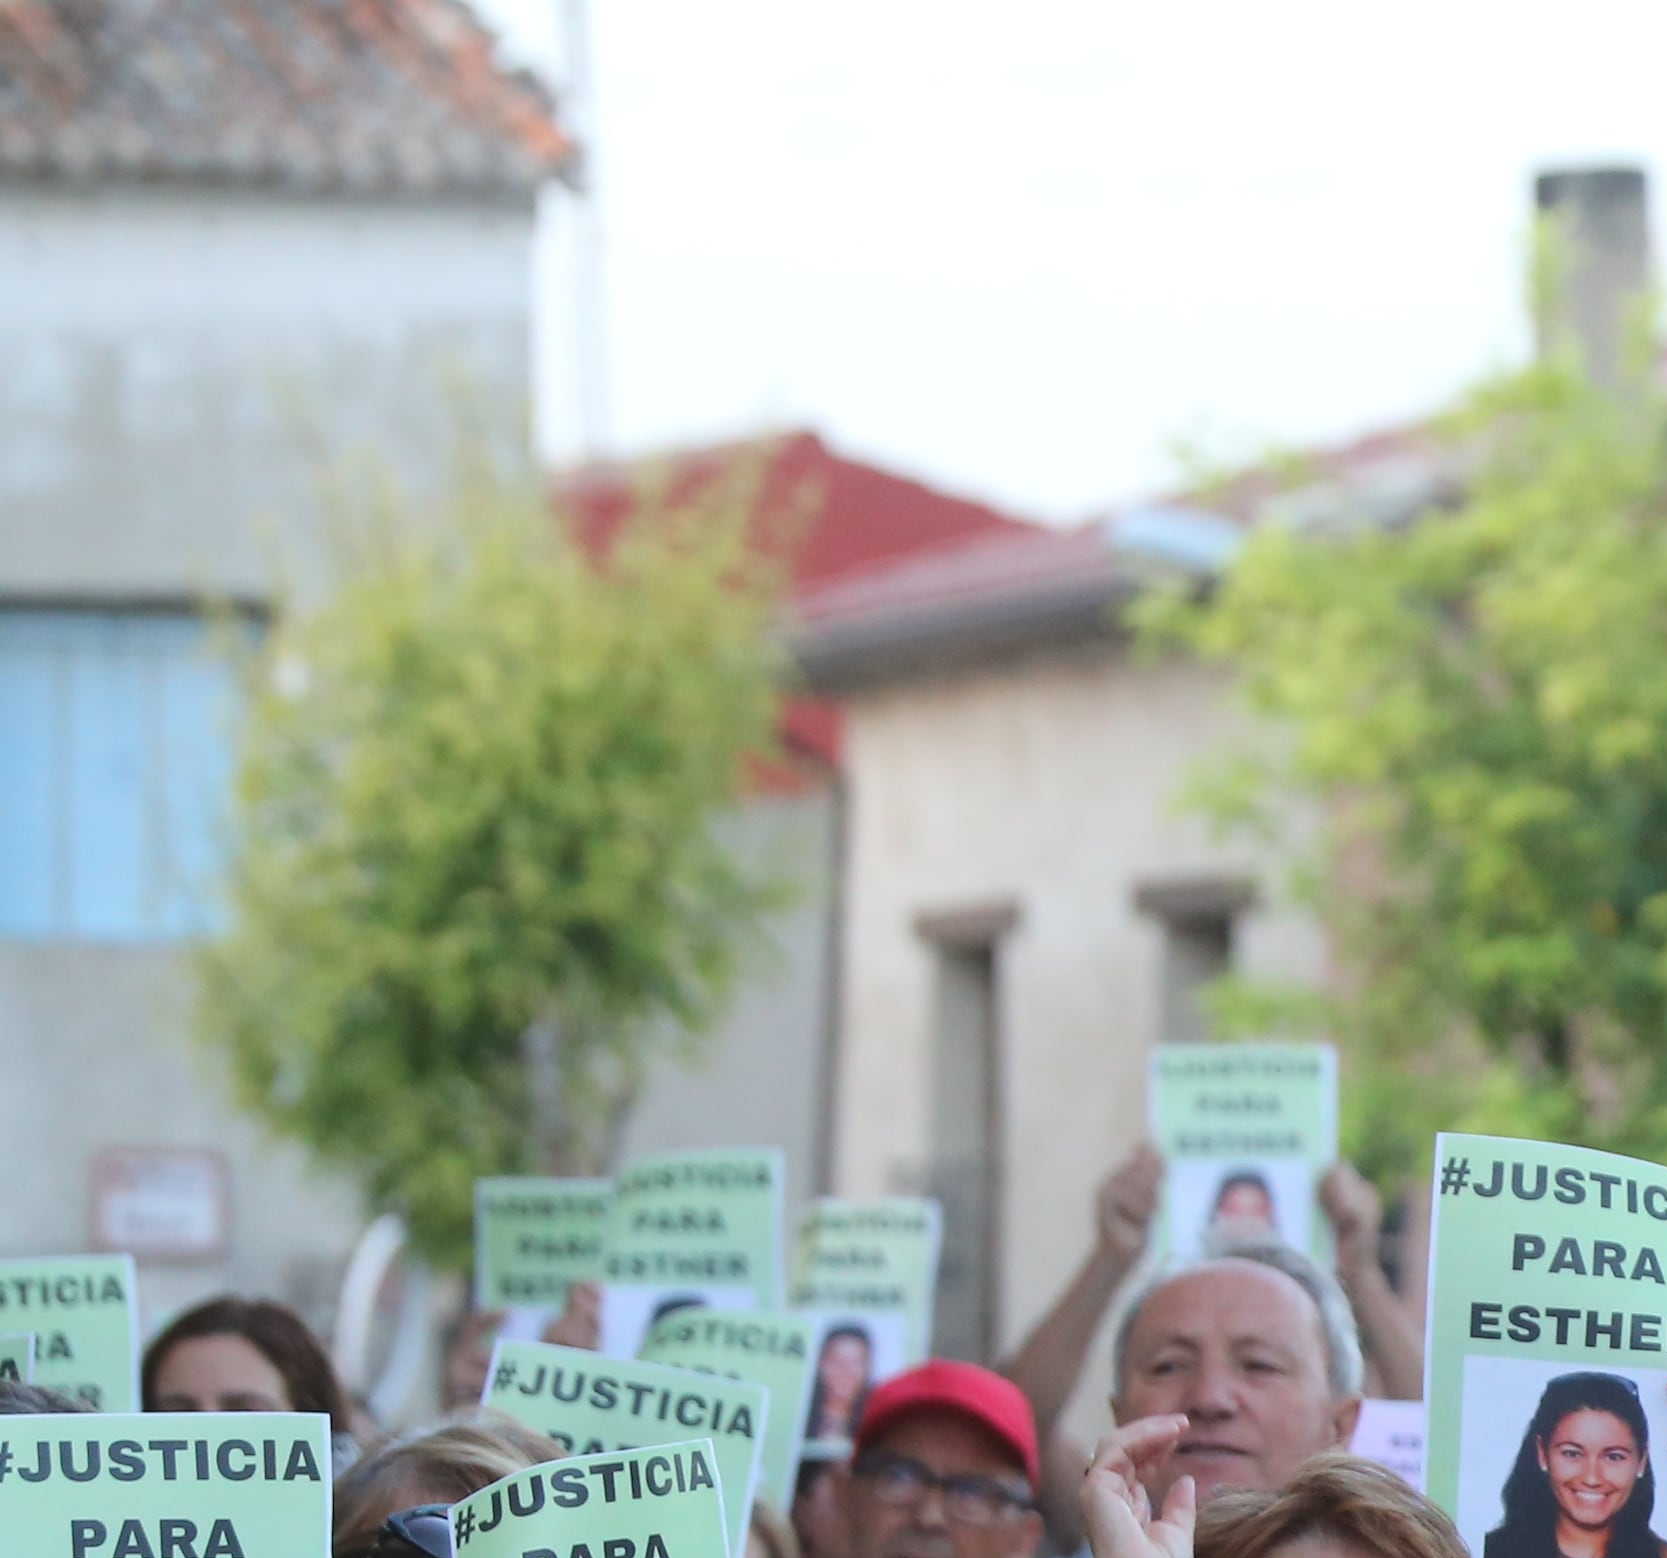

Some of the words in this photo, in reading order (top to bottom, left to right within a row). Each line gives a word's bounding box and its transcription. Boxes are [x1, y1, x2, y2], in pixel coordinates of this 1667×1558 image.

[0, 1273, 126, 1307] TICIA
[1512, 1233, 1666, 1285] PARA
[494, 1359, 754, 1438] #JUSTICIA
[455, 1451, 714, 1549] #JUSTICIA
